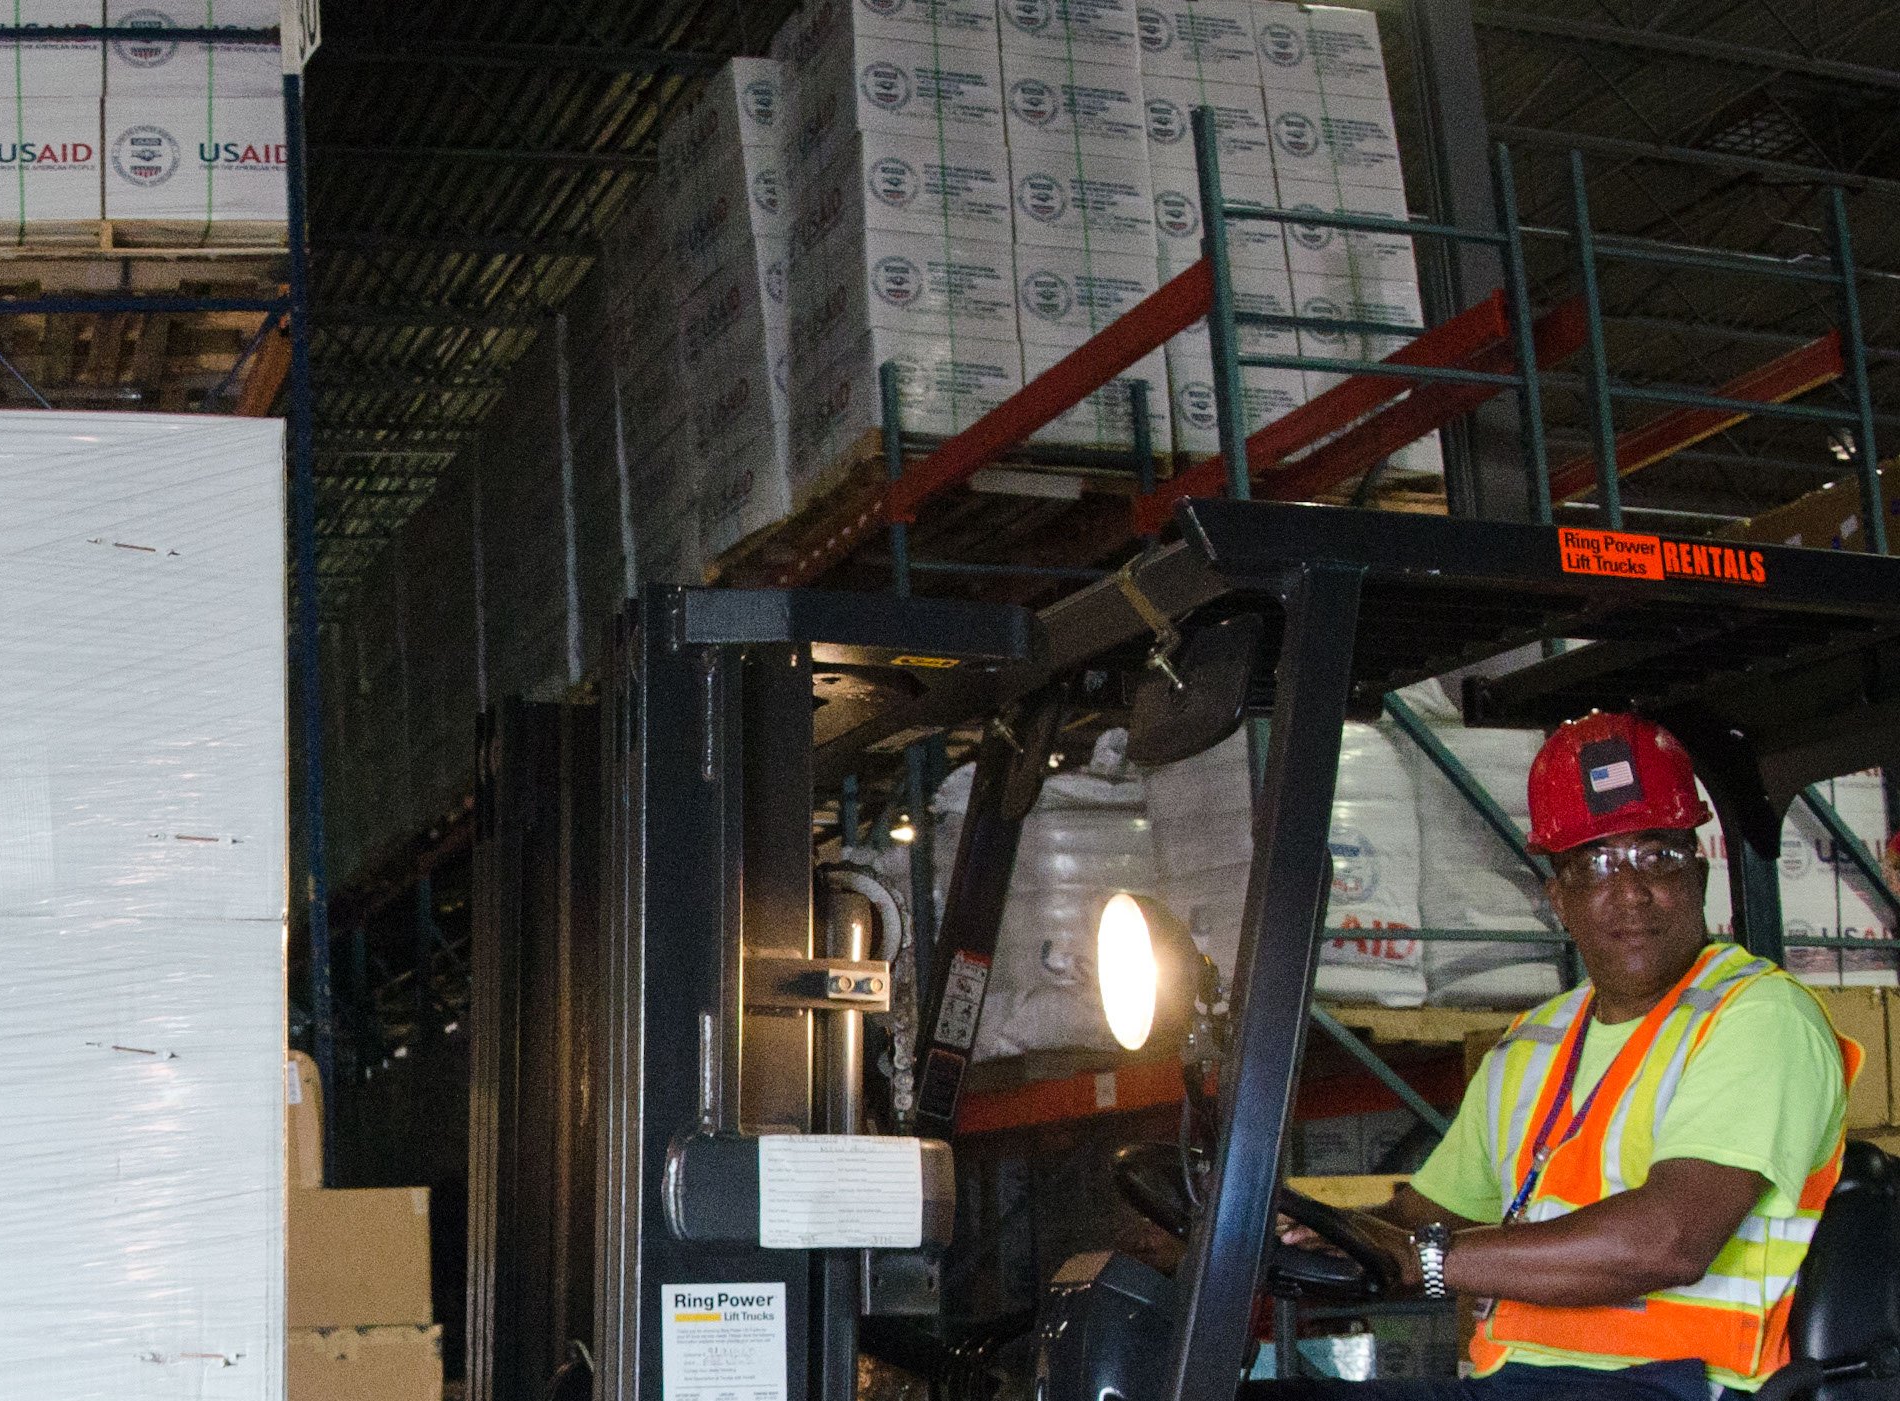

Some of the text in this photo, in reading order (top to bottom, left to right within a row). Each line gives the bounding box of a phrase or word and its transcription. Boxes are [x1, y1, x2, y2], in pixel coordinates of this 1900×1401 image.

[1564, 531, 1656, 556] Ring Power
[1567, 553, 1647, 576] Lift Trucks
[1663, 541, 1767, 584] RENTALS
[1332, 914, 1417, 960] AID
[675, 1293, 774, 1311] Ring Power
[724, 1311, 775, 1321] Lift Trucks
